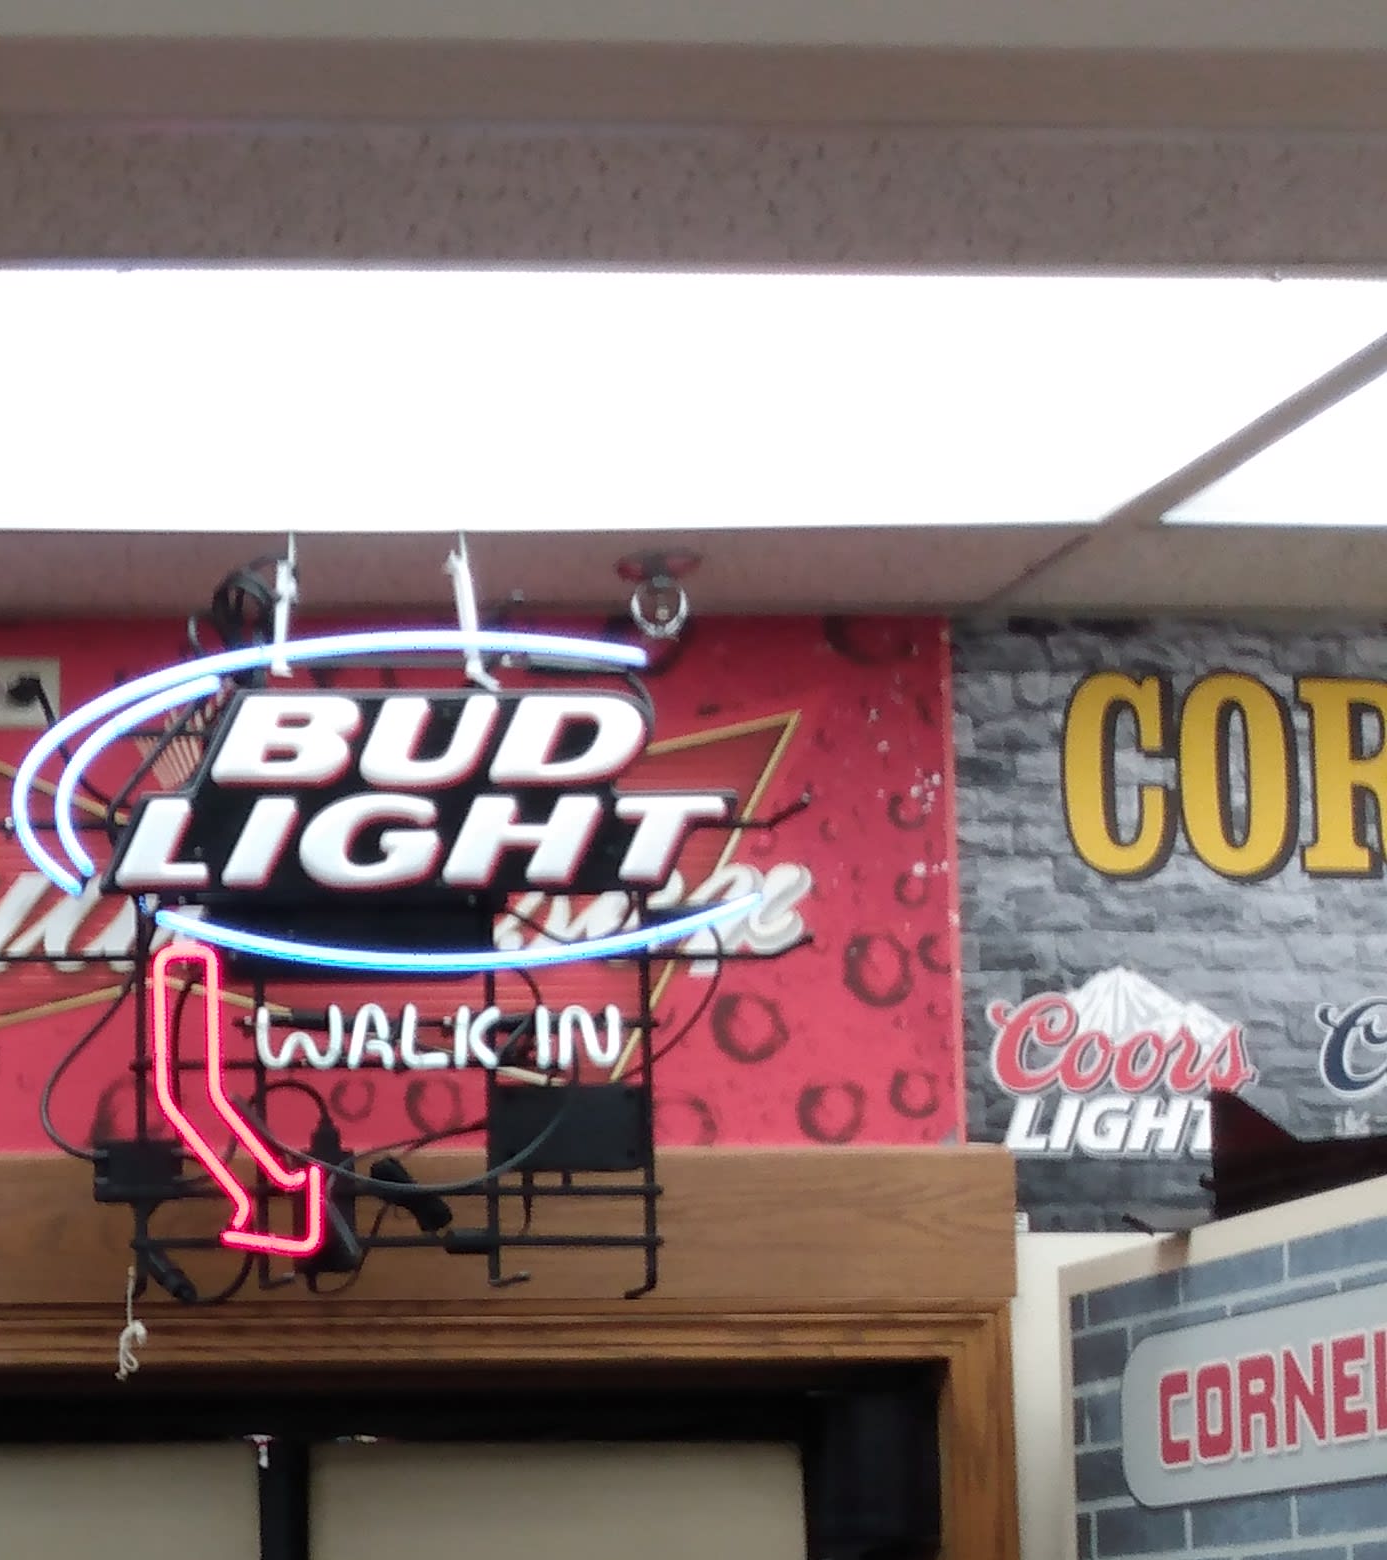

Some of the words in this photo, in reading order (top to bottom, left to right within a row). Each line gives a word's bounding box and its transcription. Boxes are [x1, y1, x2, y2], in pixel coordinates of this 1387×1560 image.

[211, 692, 655, 788] BUD
[111, 792, 738, 891] LIGHT
[255, 1005, 501, 1072] WALK
[509, 1003, 625, 1069] IN
[986, 991, 1258, 1096] Coors
